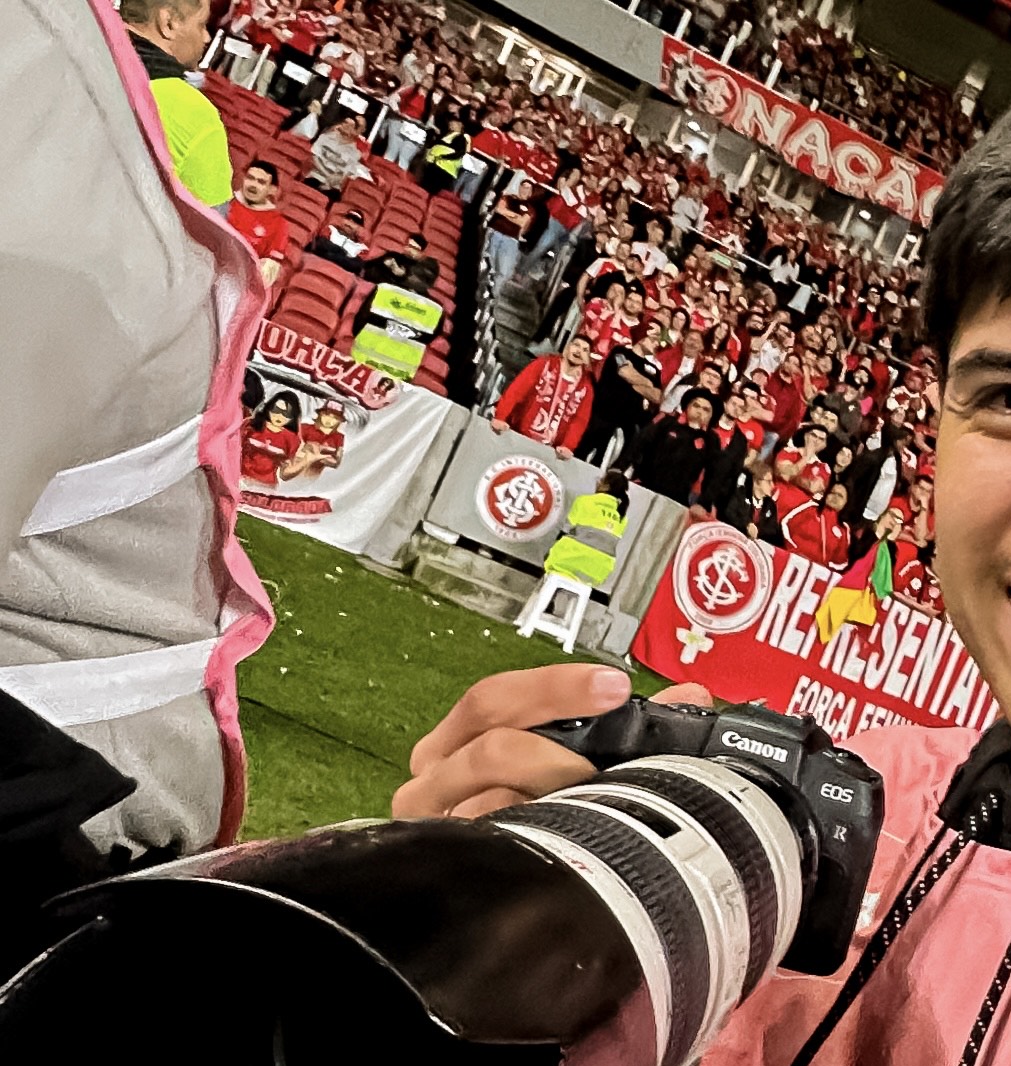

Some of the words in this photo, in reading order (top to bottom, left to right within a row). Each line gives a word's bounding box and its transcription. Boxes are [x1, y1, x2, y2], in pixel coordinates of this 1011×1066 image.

[721, 730, 789, 763] Canon
[820, 782, 855, 803] EOS
[833, 824, 848, 843] R
